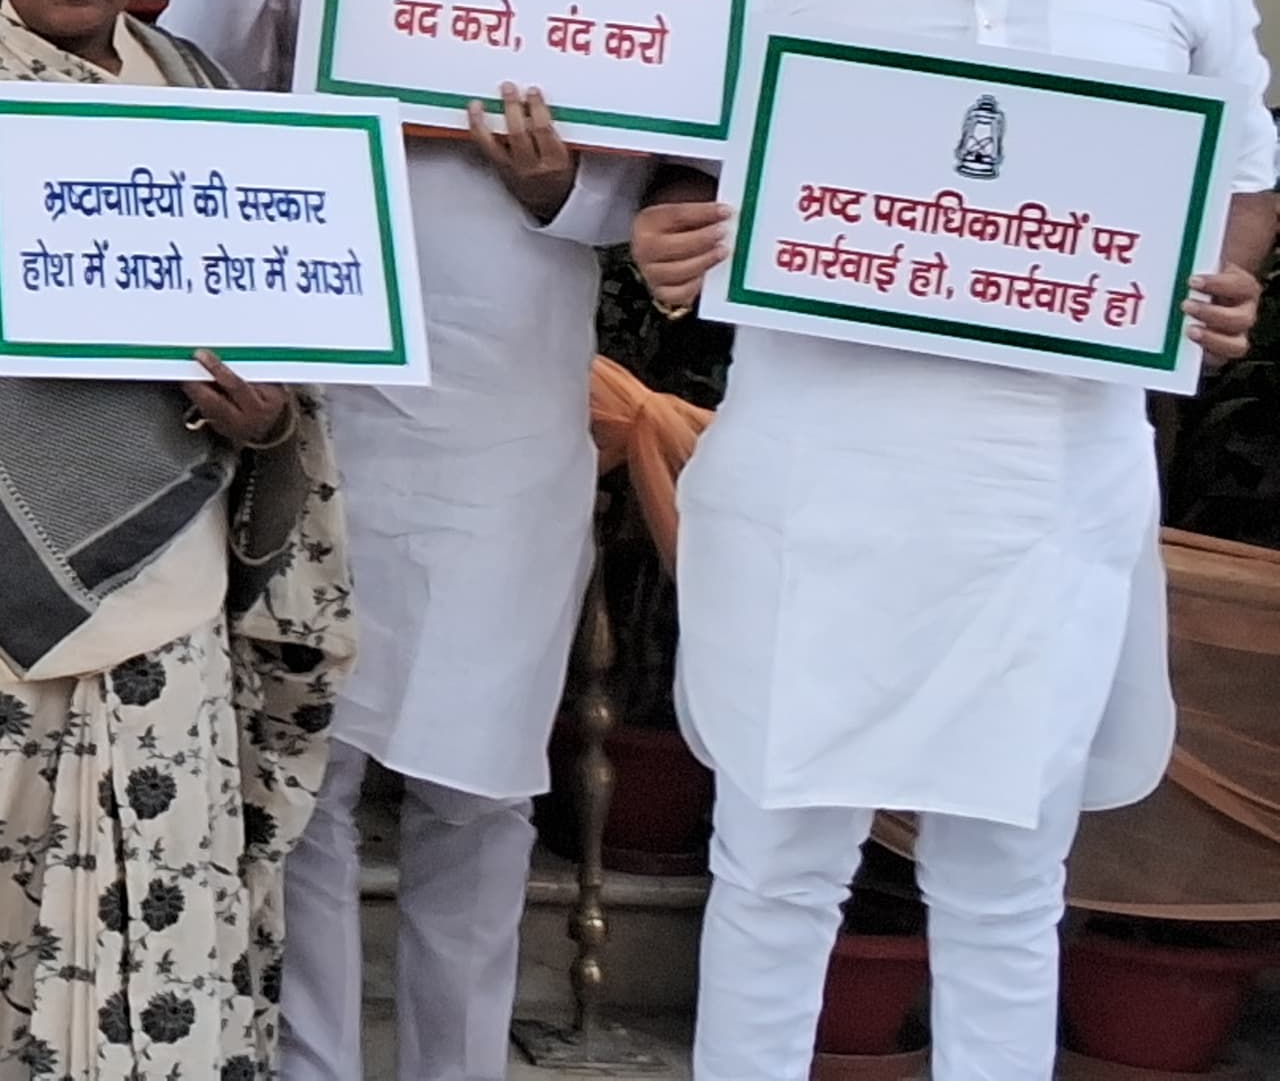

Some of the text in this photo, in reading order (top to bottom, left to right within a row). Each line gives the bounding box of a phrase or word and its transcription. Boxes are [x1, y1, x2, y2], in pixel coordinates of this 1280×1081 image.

[547, 5, 596, 55] बंद
[605, 15, 669, 65] करो
[44, 167, 327, 224] भ्रष्टाचारियों की सरकार
[798, 183, 1140, 264] भ्रष्ट पदाधिकारियों पर
[20, 240, 363, 296] होश में आओ, होश में आओ
[776, 234, 1144, 327] कार्रवाई हो, कार्रवाई हो
